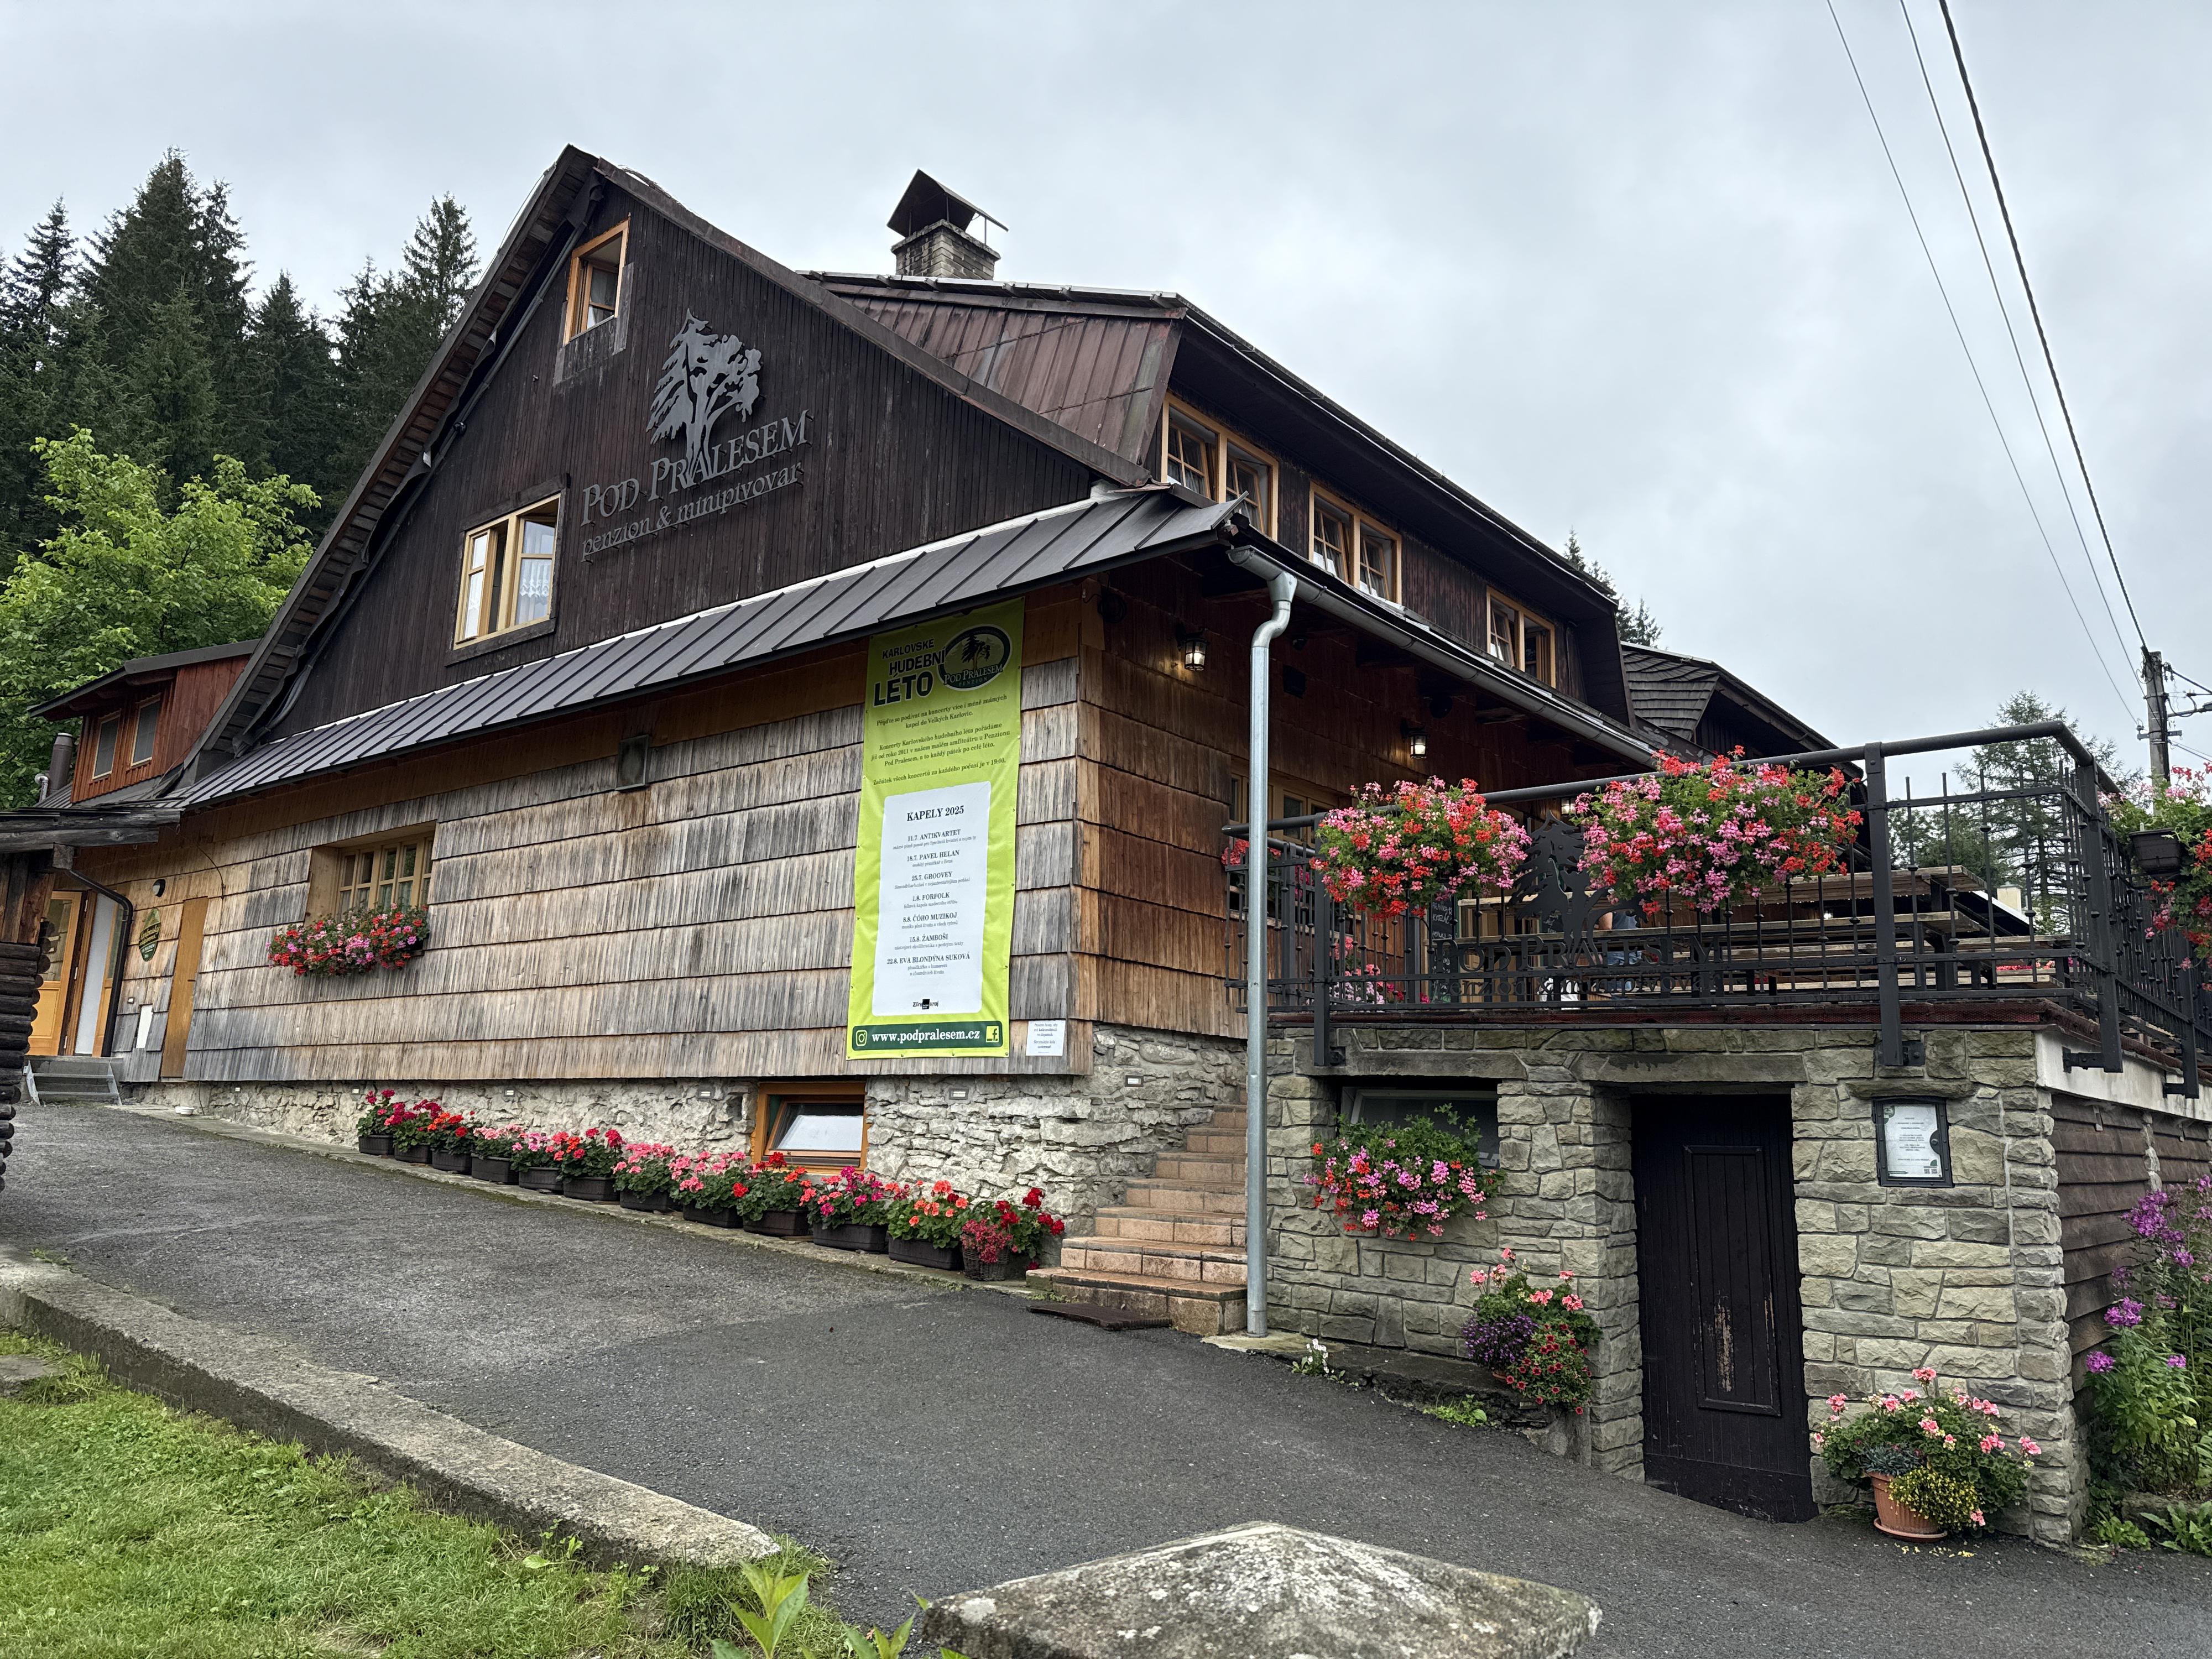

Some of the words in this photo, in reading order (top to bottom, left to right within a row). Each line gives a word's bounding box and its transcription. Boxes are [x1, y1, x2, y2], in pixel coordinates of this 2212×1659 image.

[581, 478, 640, 526] POD
[648, 409, 810, 502] PRALESEM
[581, 517, 650, 562] penzion
[656, 506, 671, 529] &
[677, 462, 801, 514] minipivovar
[889, 646, 946, 675] HUDEBNÍ
[945, 674, 961, 684] POD
[963, 664, 1003, 680] PRALESEM
[874, 671, 933, 706] LÉTO
[901, 712, 920, 722] podívat
[928, 706, 951, 716] koncerty
[967, 699, 982, 707] méně
[983, 694, 1007, 704] známých
[950, 711, 973, 719] Karlovic.
[902, 735, 933, 746] Karlovského
[934, 730, 962, 740] hudebního
[975, 723, 1002, 734] pořádáme
[984, 731, 1010, 739] Penzionu
[894, 756, 919, 765] Pralesem,
[930, 750, 945, 758] každý
[947, 747, 962, 756] pátek
[874, 777, 892, 785] Začátek
[908, 770, 930, 779] koncertů
[938, 765, 960, 774] každého
[961, 763, 978, 771] počasí
[907, 808, 943, 821] KAPELY
[945, 805, 964, 816] 2025
[920, 829, 961, 840] ANTIKVARTET
[924, 871, 953, 879] GROOVEY
[922, 892, 950, 901] FORFOLK
[930, 912, 958, 921] MUZIKOJ
[922, 932, 948, 942] ŽAMBOŠI
[912, 954, 944, 963] BLONDÝNA
[945, 952, 970, 961] SUKOVÁ
[1433, 940, 1511, 972] POD
[872, 1028, 980, 1044] www.podpralesem.cz
